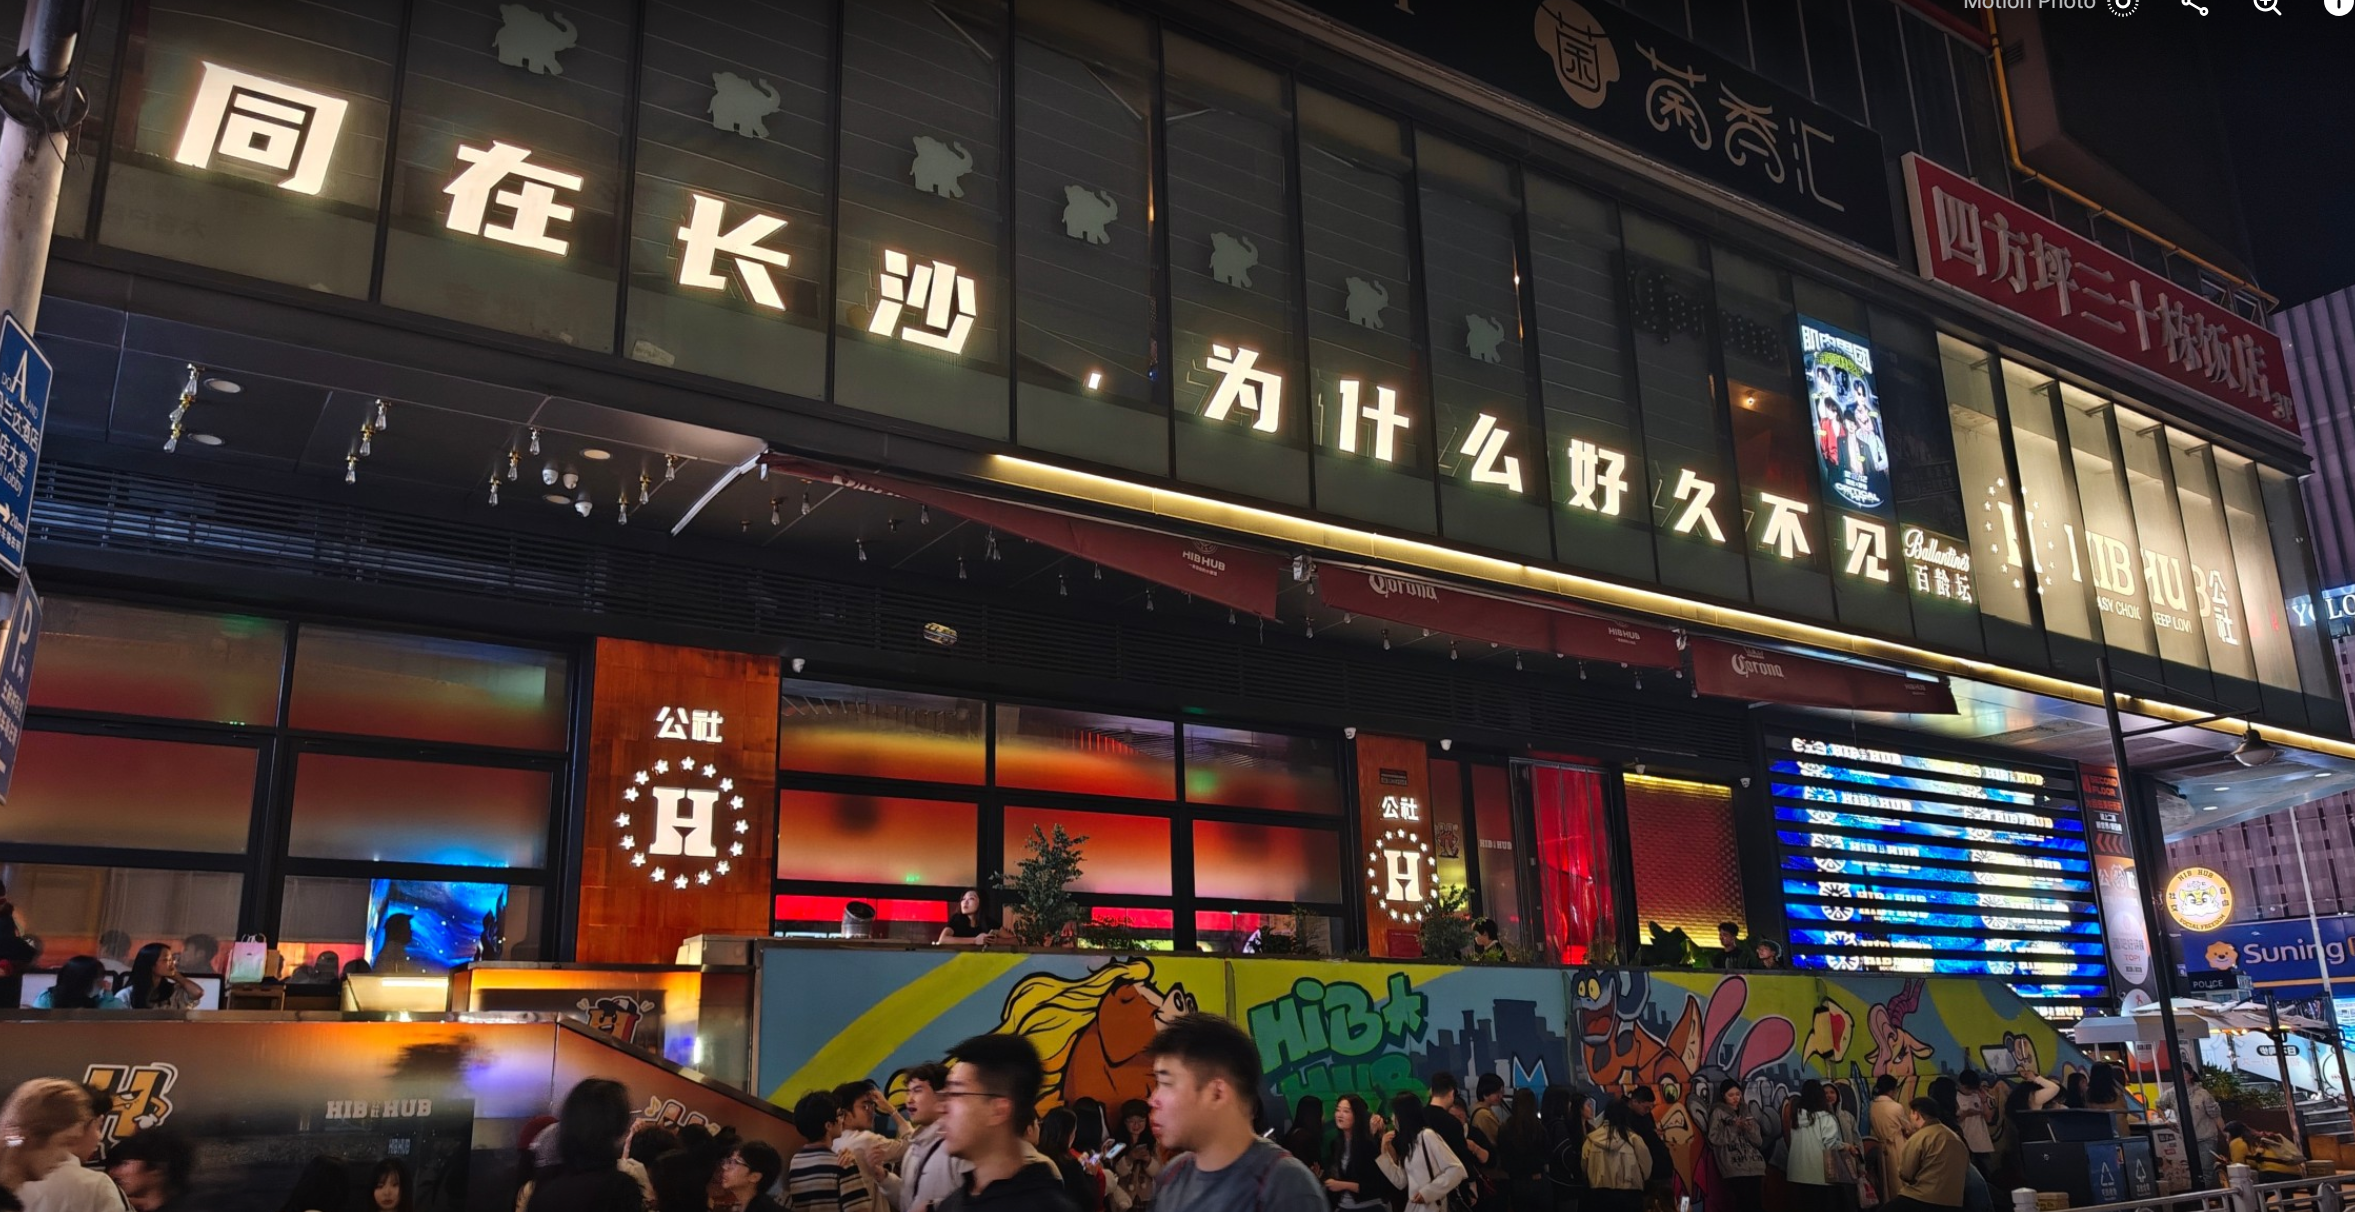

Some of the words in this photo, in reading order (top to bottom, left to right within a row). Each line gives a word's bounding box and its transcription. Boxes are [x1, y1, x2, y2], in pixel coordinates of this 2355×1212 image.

[1932, 185, 2270, 402] 四方坪三十栋饭店
[0, 433, 28, 478] 店大堂
[1369, 574, 1439, 602] Corona
[12, 595, 33, 674] P
[1731, 654, 1786, 679] Corona
[656, 706, 724, 743] 公社
[649, 786, 719, 858] H
[1381, 795, 1419, 821] 公社
[1383, 849, 1423, 901] H
[2193, 980, 2224, 989] POLICE
